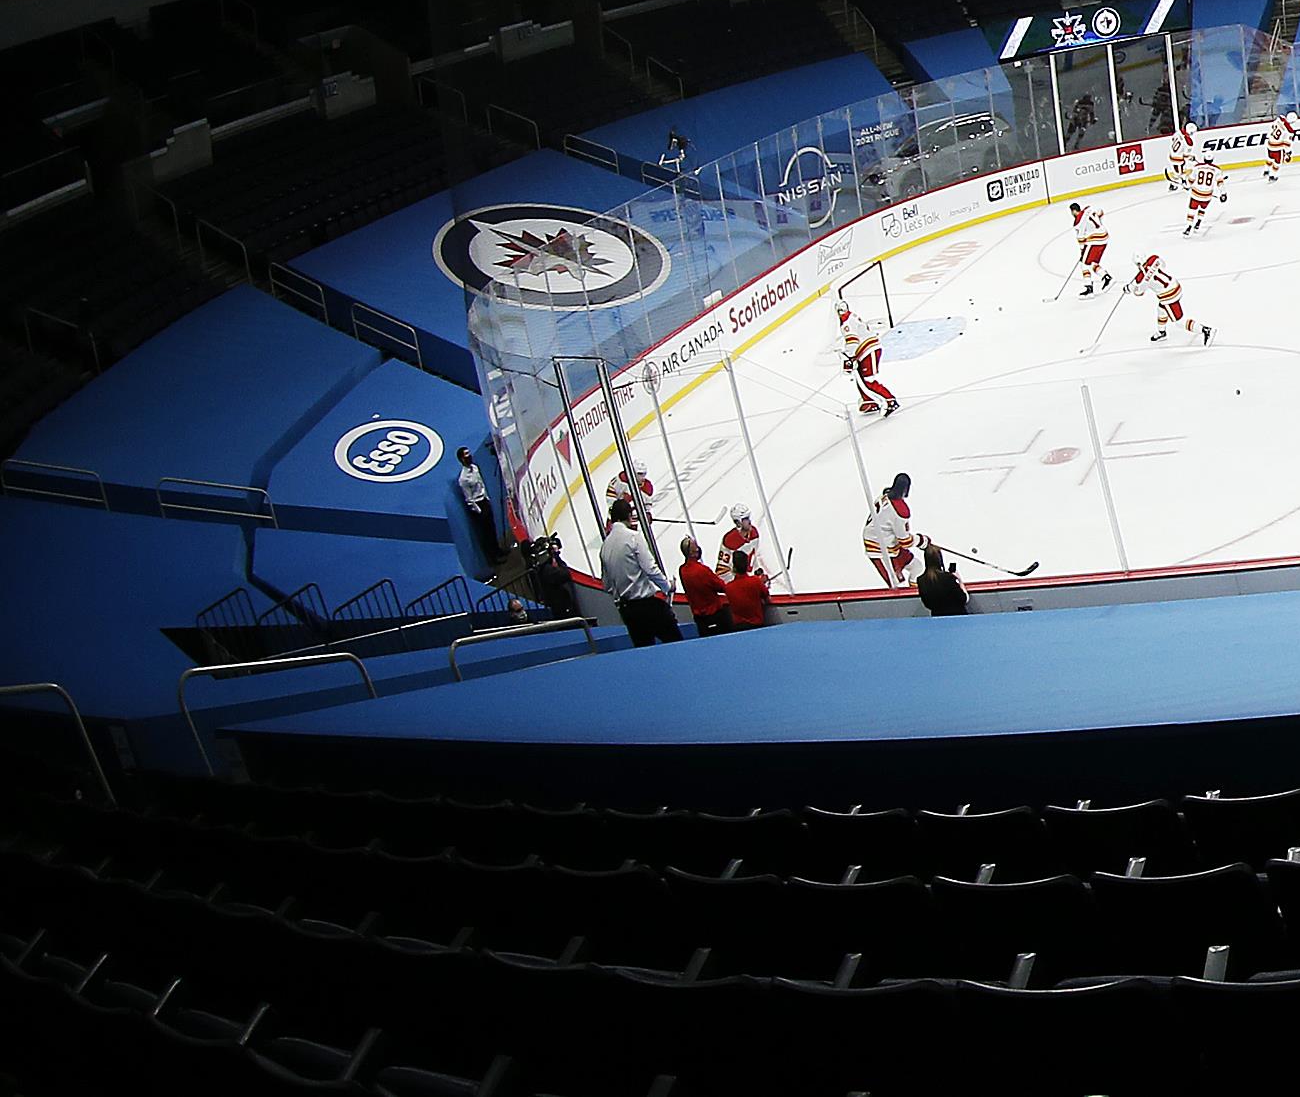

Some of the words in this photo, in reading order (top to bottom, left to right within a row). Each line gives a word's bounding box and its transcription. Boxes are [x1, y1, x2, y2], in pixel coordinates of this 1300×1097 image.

[1075, 158, 1115, 176] canada
[1118, 149, 1144, 171] life
[777, 171, 843, 205] NISSAN
[1004, 168, 1040, 187] DOWNLOAD
[1197, 170, 1214, 187] 88
[1006, 186, 1017, 197] THE
[1018, 182, 1032, 194] APP
[902, 203, 919, 221] Bell
[729, 269, 799, 334] Scotiabank
[662, 352, 680, 378] AIR
[680, 321, 724, 363] CANADA
